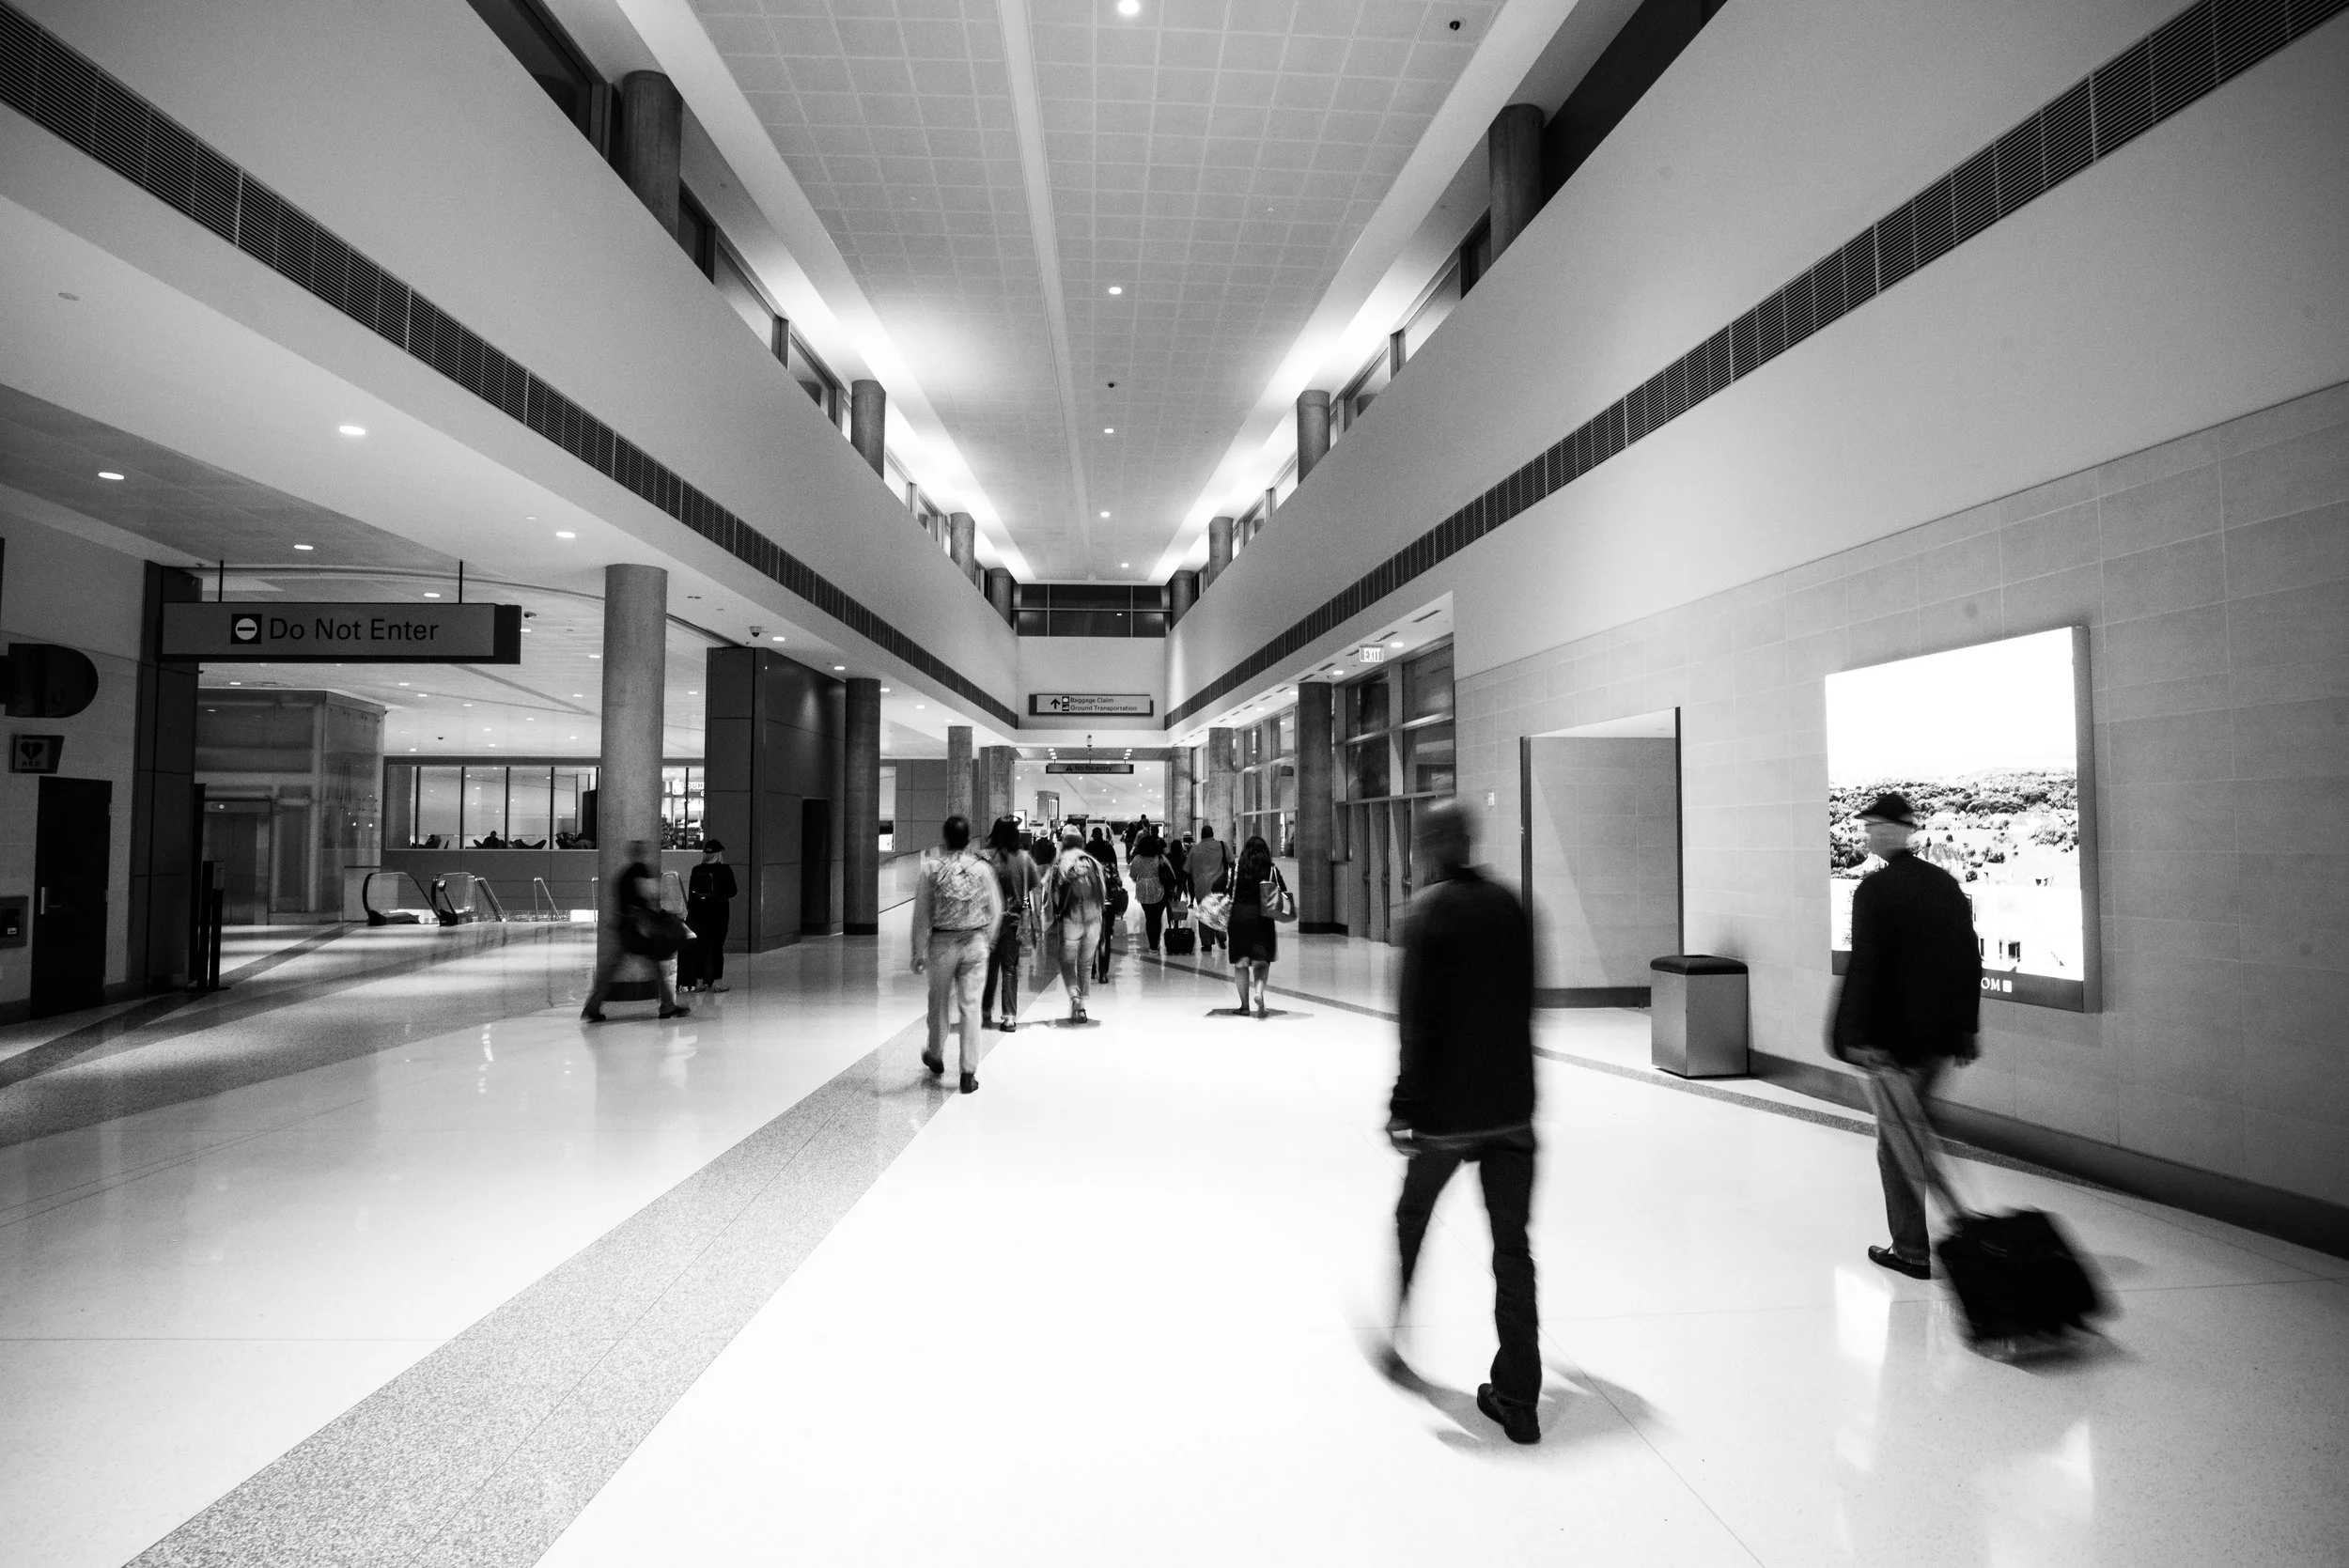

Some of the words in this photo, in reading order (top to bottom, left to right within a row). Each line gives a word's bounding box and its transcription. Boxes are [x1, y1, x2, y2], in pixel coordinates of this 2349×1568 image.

[269, 617, 305, 641] Do
[315, 617, 362, 641] Not
[369, 618, 440, 641] Enter
[1363, 647, 1381, 662] EXIT
[1980, 976, 2001, 992] OM
